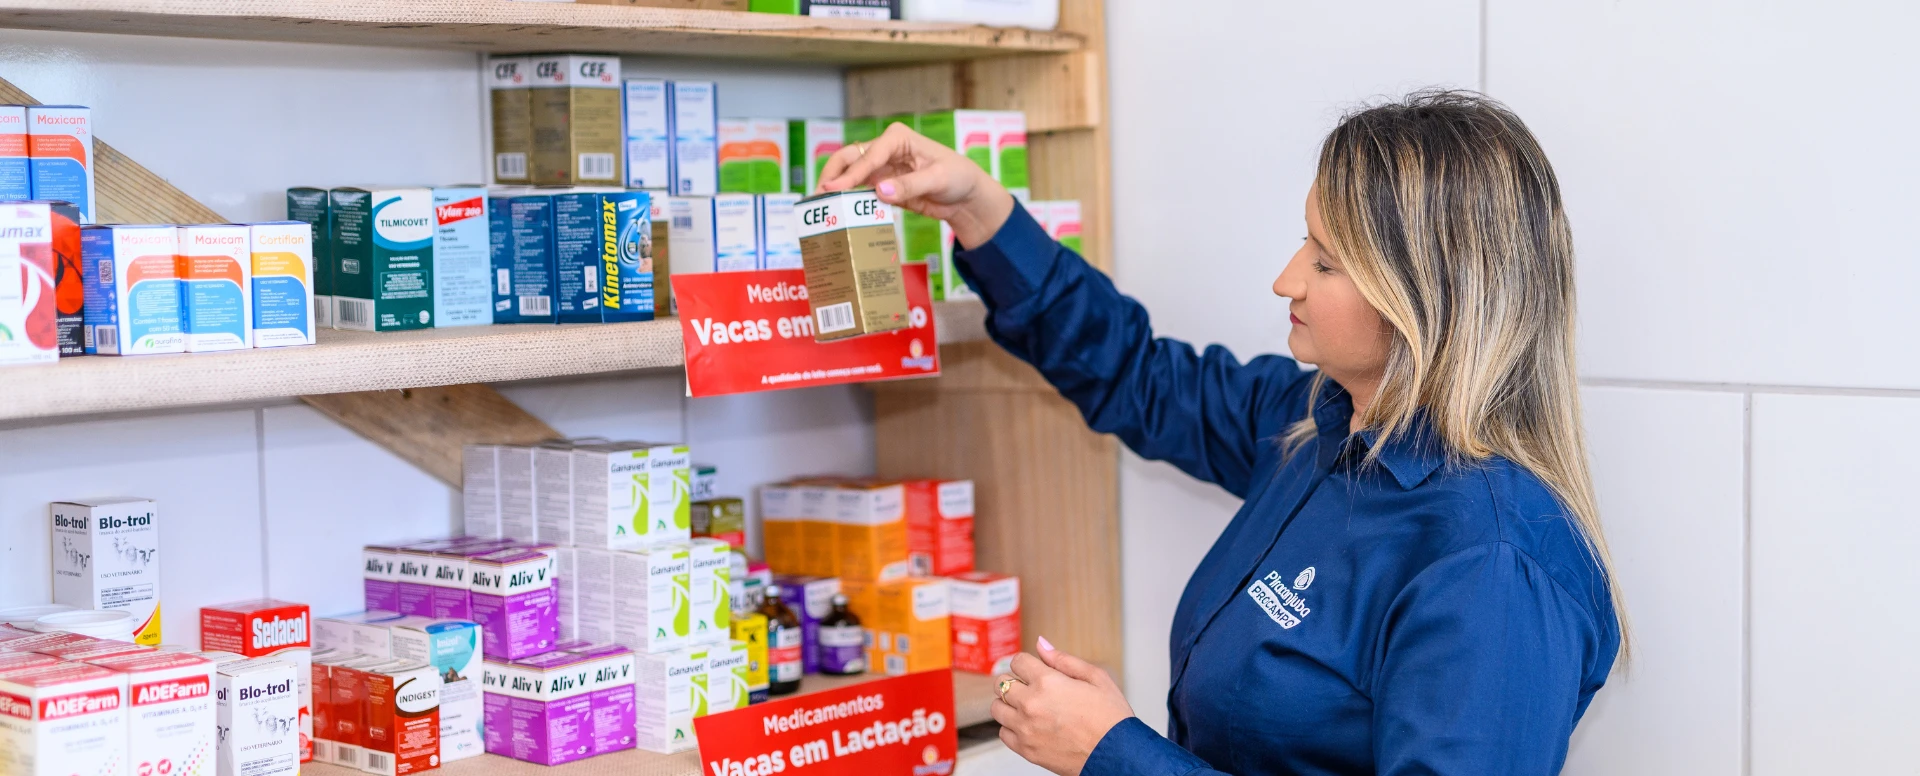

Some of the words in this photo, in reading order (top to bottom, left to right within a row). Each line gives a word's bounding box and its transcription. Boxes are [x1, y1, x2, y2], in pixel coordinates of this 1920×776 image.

[496, 62, 518, 80] CEF
[537, 62, 558, 79] CEF
[580, 62, 606, 78] CEF
[37, 114, 86, 125] Maxicam
[76, 127, 86, 135] 2%
[438, 206, 462, 220] Tylan
[803, 206, 829, 226] CEF
[826, 216, 837, 227] 50
[854, 199, 877, 216] CEF
[875, 210, 885, 220] 50
[380, 218, 429, 228] TILMICOVET
[121, 235, 171, 245] Maxicam
[195, 235, 244, 245] Maxicam
[259, 234, 305, 245] Cortiflan
[234, 247, 244, 255] 2%
[602, 200, 620, 310] Kinetomax
[746, 282, 809, 303] Medica
[133, 317, 156, 325] Contém
[690, 316, 772, 346] Vacas
[777, 314, 816, 339] em
[611, 463, 645, 473] Ganavet
[651, 458, 685, 468] Ganavet
[99, 512, 151, 530] Blo-trol
[366, 560, 384, 573] Aliv
[386, 562, 393, 574] V
[399, 562, 418, 576] Aliv
[421, 565, 428, 577] V
[651, 563, 685, 576] Ganavet
[693, 558, 726, 569] Ganavet
[436, 566, 454, 580] Aliv
[457, 568, 464, 581] V
[472, 571, 491, 587] Aliv
[493, 575, 501, 589] V
[509, 573, 533, 588] Aliv
[538, 568, 546, 581] V
[1251, 585, 1295, 627] PROCAMPO
[252, 611, 307, 649] Sedacol
[668, 663, 704, 677] Ganavet
[709, 655, 744, 669] Ganavet
[483, 670, 496, 686] liv
[499, 674, 507, 688] V
[595, 666, 618, 683] Aliv
[622, 664, 630, 677] V
[239, 678, 291, 701] Blo-trol
[512, 676, 532, 692] Aliv
[535, 680, 543, 694] V
[550, 676, 574, 693] Aliv
[579, 672, 586, 686] V
[138, 681, 207, 704] ADEFarm
[399, 690, 436, 703] INDIGEST
[0, 696, 31, 717] EFarm
[45, 694, 118, 717] ADEFarm
[142, 708, 180, 720] VITAMINAS
[763, 693, 884, 736] Medicamentos
[710, 749, 786, 776] Vacas
[790, 741, 829, 768] em
[832, 707, 946, 757] Lactação
